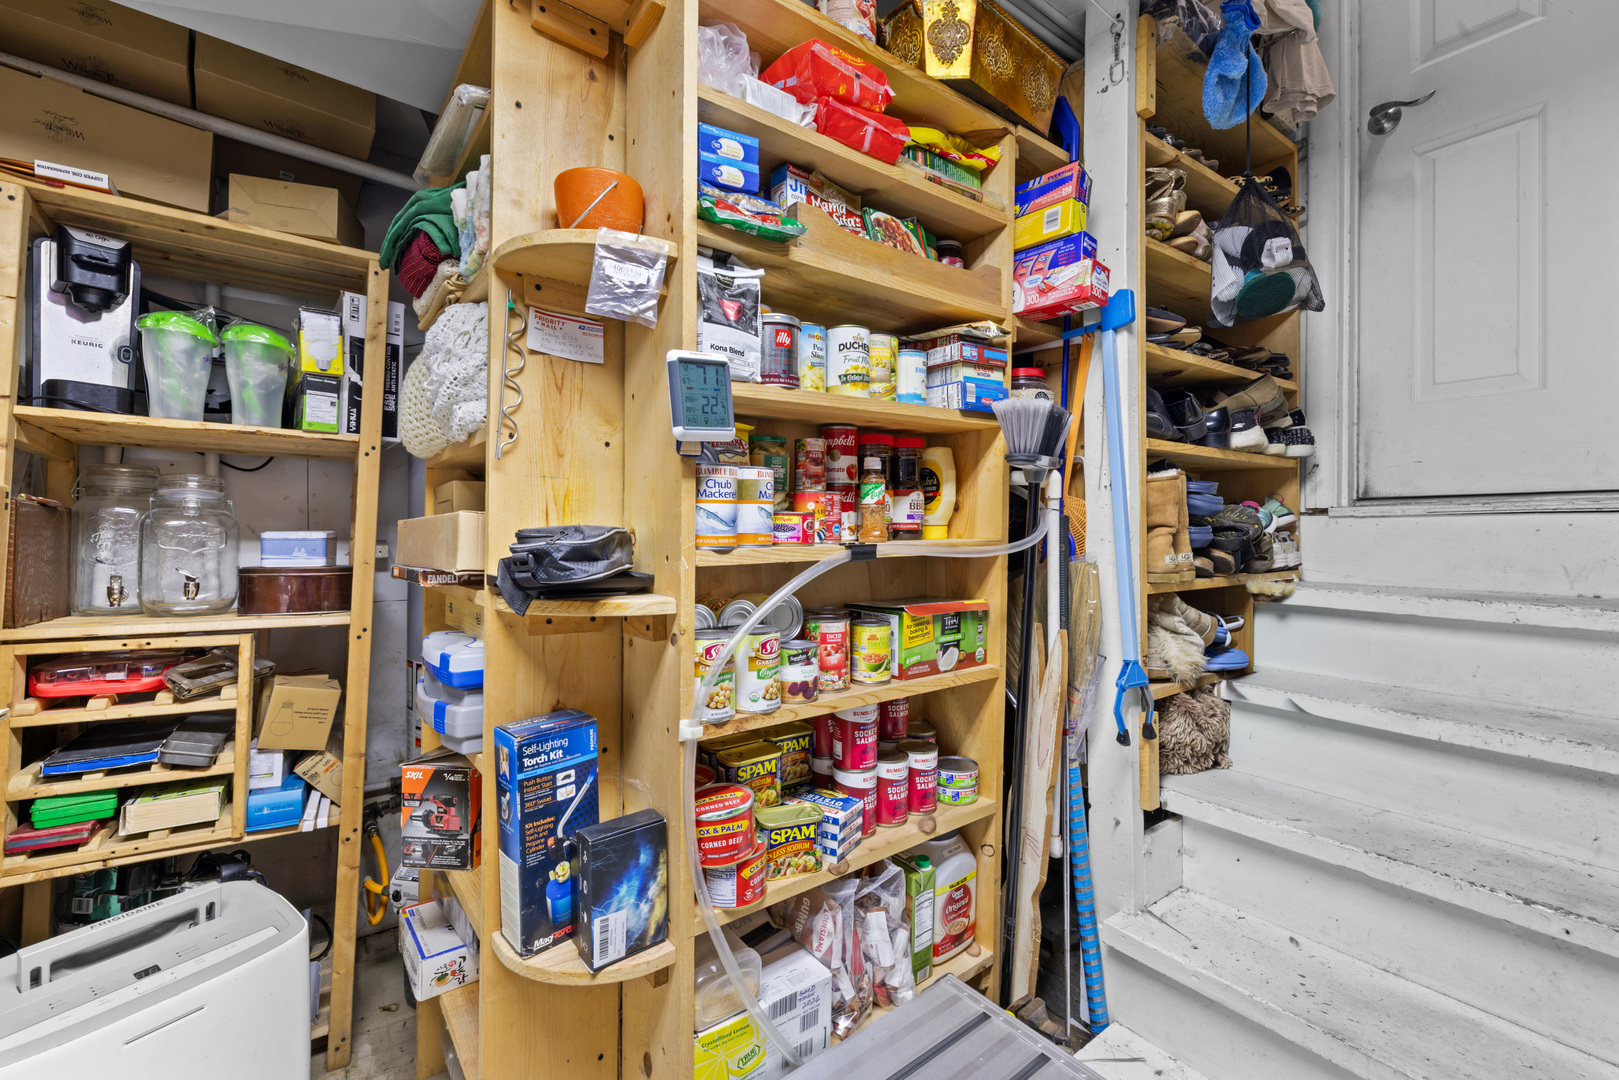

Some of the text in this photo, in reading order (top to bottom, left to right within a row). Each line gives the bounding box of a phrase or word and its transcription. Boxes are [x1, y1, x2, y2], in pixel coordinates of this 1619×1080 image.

[36, 164, 70, 175] REFRIGERATION
[84, 174, 104, 182] COPPER
[811, 196, 846, 214] Mama
[833, 212, 862, 227] Sita's
[1092, 285, 1102, 298] 300
[1026, 294, 1040, 306] 300
[534, 314, 566, 326] PRIORITY
[541, 322, 557, 331] MAIL
[71, 339, 104, 349] KEURIG
[776, 332, 791, 346] illy
[710, 343, 745, 357] Kona Blend
[696, 365, 720, 385] 71
[696, 467, 727, 476] BUMBLE
[705, 478, 732, 489] Chub
[696, 489, 737, 499] Mackerel
[427, 573, 459, 584] FANDELI
[944, 616, 959, 625] THAI
[522, 737, 569, 756] Self-Lighting
[323, 759, 331, 767] LED
[523, 749, 563, 767] Torch Kit
[405, 771, 424, 780] SKIL
[738, 760, 777, 782] SPAM
[523, 780, 553, 793] Instant Start
[524, 775, 553, 787] Push Button
[537, 796, 552, 805] Swivel
[696, 803, 723, 812] CORNED
[533, 816, 556, 826] Includes:
[525, 823, 554, 835] Self-Lighting
[698, 828, 711, 836] OX
[721, 823, 744, 833] PALM
[771, 824, 816, 845] SPAM
[526, 833, 538, 843] Torch
[526, 838, 545, 849] Propane
[701, 836, 743, 849] CORNED BEEF
[526, 844, 545, 854] Cylinder
[773, 842, 810, 859] LESS SODIUM
[947, 846, 962, 854] SUGAR
[750, 863, 760, 874] OX
[949, 881, 959, 889] VALUE
[952, 888, 964, 898] Great
[946, 896, 969, 914] Original
[90, 902, 164, 929] FRIGIDAIRE
[814, 908, 831, 953] LOUISIANA
[534, 925, 572, 951] MagTorc
[733, 1024, 750, 1035] Lemon
[740, 1047, 756, 1064] TRUE
